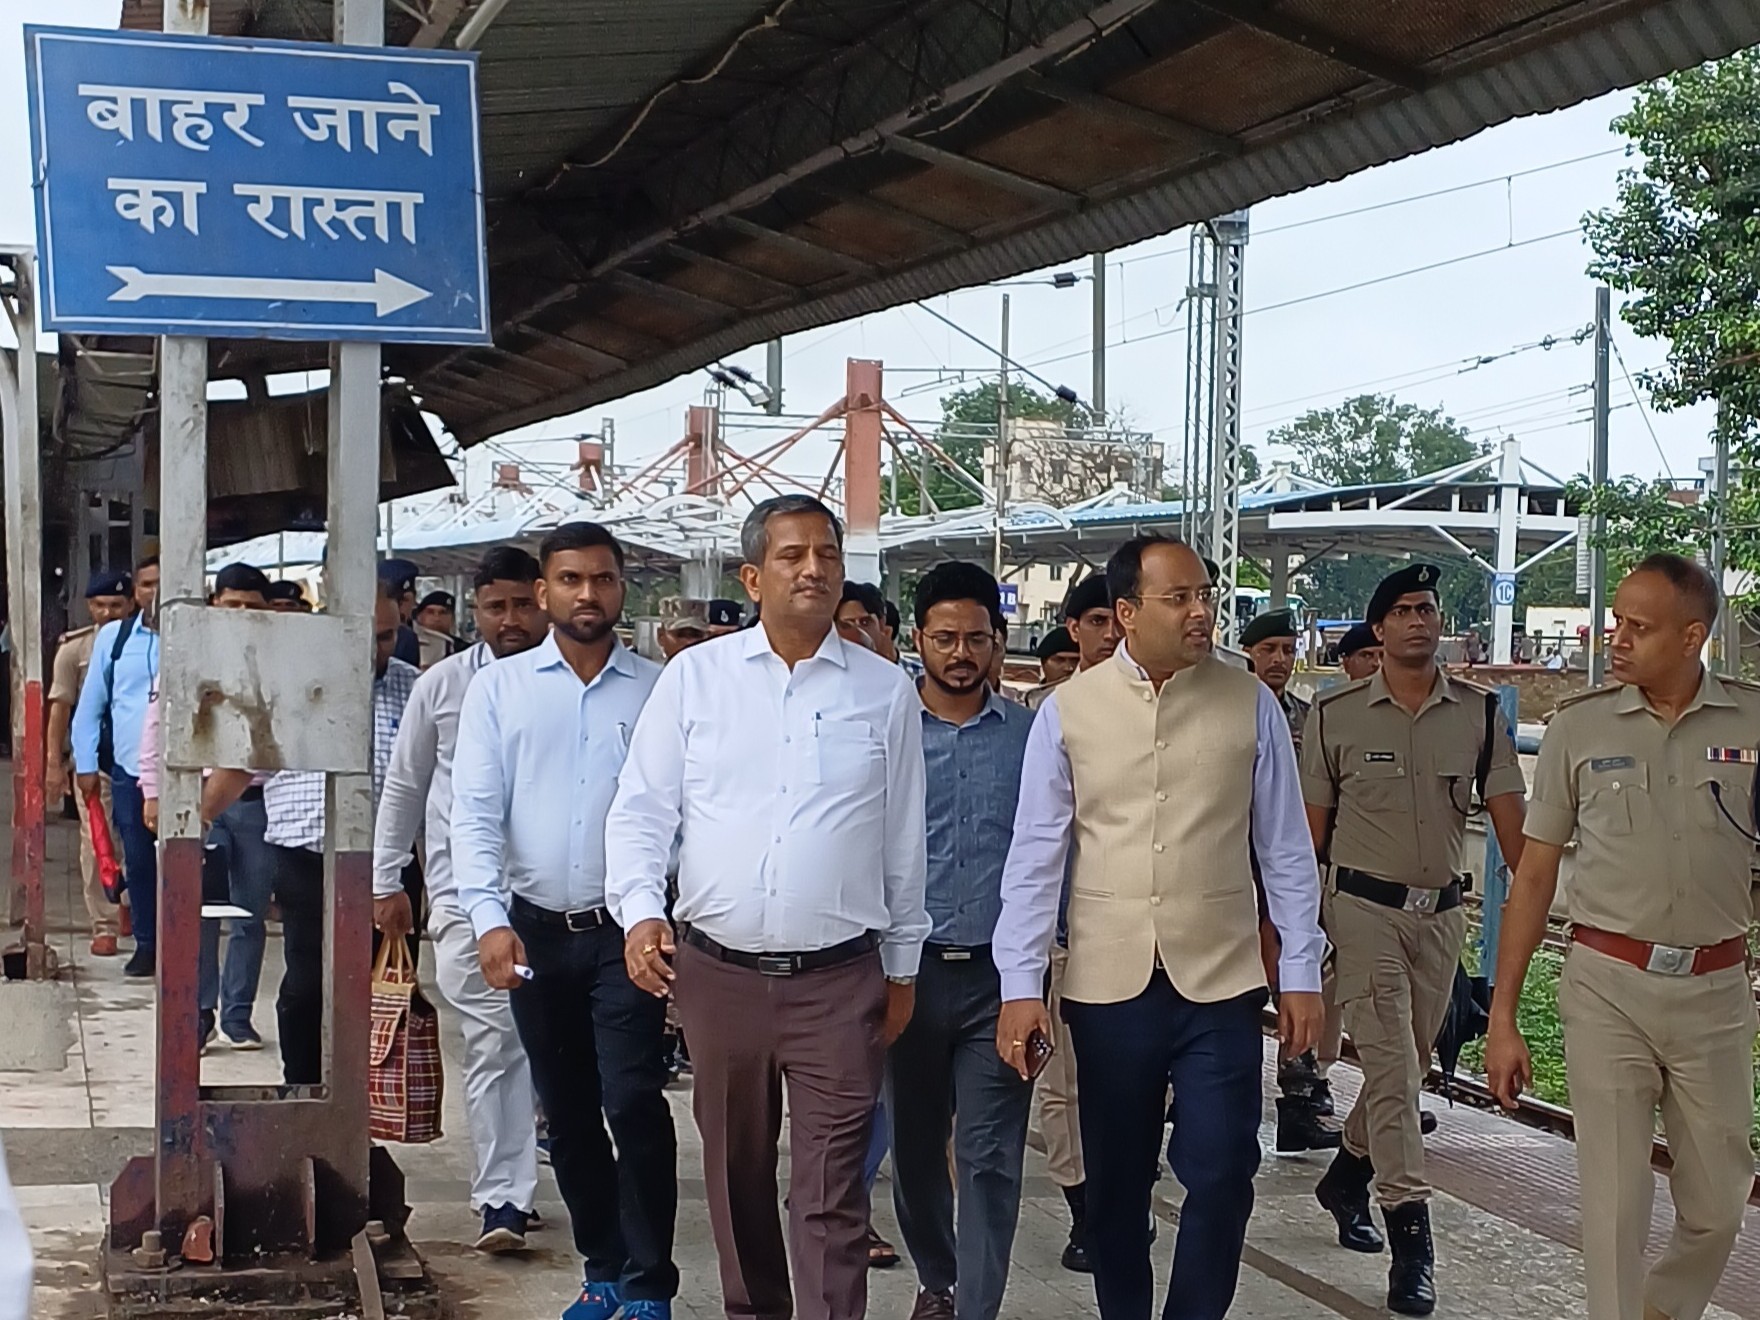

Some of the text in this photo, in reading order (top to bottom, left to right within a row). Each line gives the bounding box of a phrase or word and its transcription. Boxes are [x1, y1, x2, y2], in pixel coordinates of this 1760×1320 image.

[77, 81, 441, 157] बाहर जाने
[107, 177, 424, 244] का रास्ता
